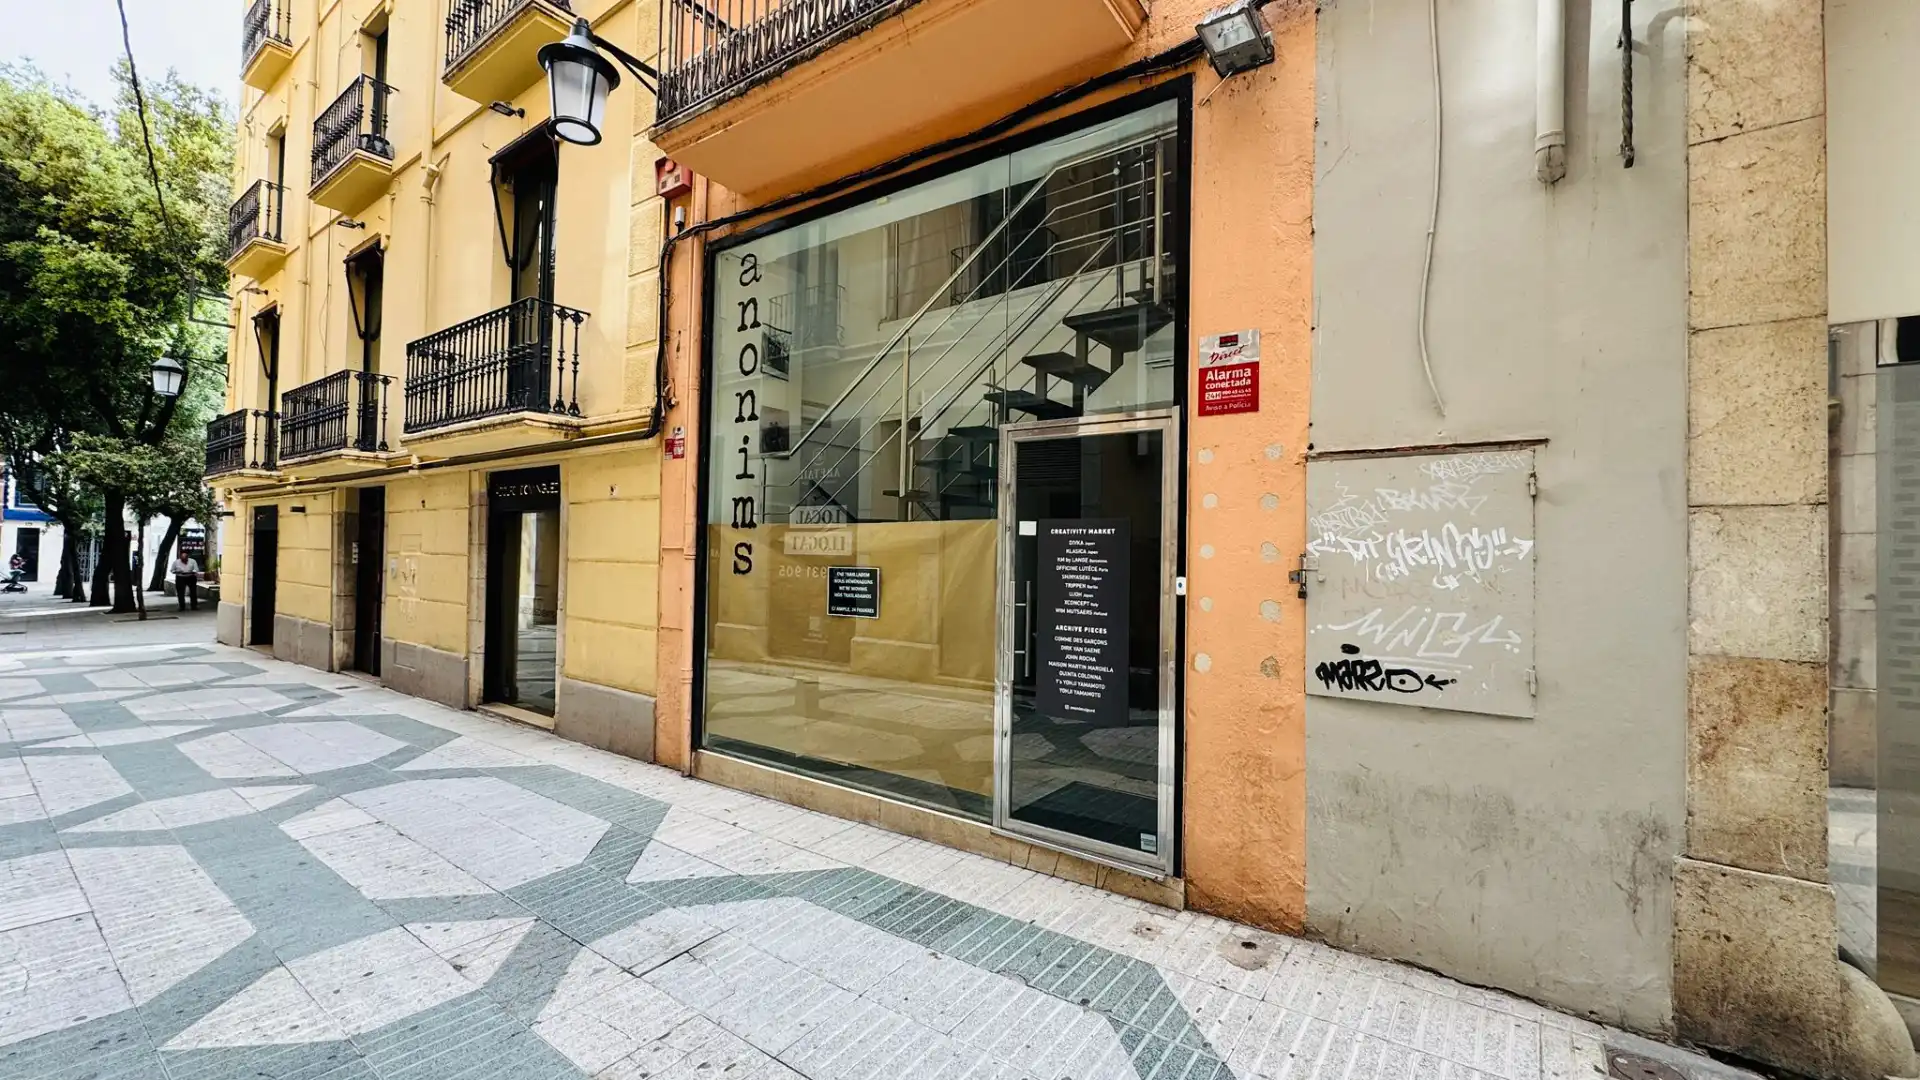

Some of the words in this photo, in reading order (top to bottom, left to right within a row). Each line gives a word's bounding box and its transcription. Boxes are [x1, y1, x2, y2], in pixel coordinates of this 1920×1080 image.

[1209, 344, 1249, 365] Direct
[1205, 367, 1252, 381] Alarma
[1205, 377, 1252, 390] conectada
[731, 252, 762, 576] anonims
[1055, 624, 1082, 633] ARCHIVE
[1084, 626, 1108, 635] PIECES
[1083, 638, 1108, 646] GARÇONS
[1048, 660, 1067, 668] MAISON
[1068, 662, 1087, 670] MARTIN
[1077, 672, 1102, 681] COLONNA
[1078, 681, 1106, 690] YAMAMOTO
[1074, 689, 1101, 698] YAMAMOTO
